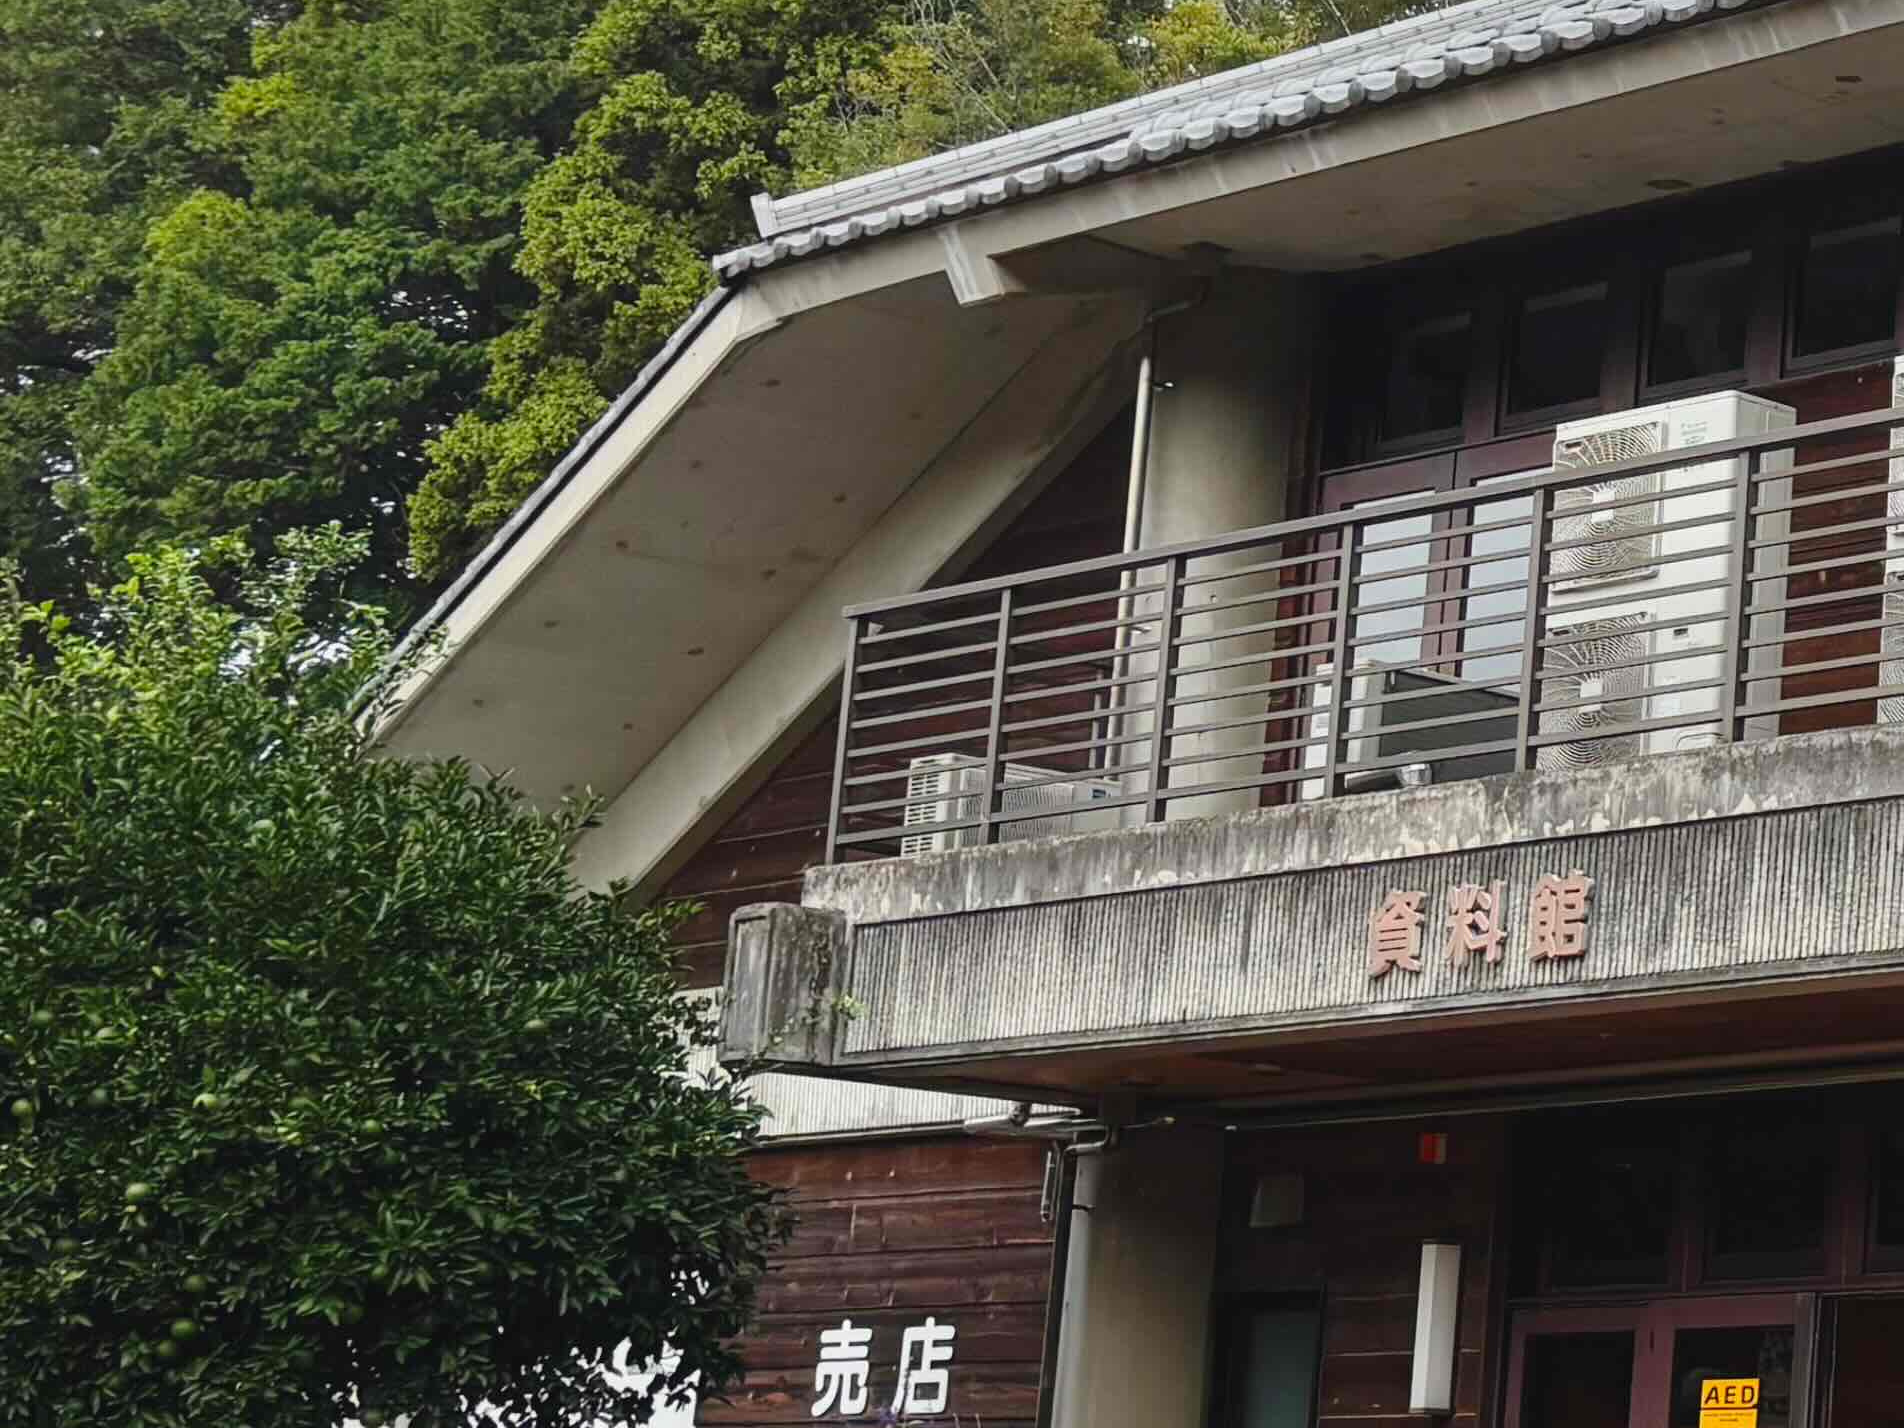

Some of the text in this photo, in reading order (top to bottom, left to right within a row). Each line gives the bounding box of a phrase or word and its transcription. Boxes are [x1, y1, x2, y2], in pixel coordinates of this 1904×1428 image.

[1369, 869, 1594, 979] 資料館
[811, 1316, 956, 1417] 売店
[1704, 1386, 1755, 1405] AED
